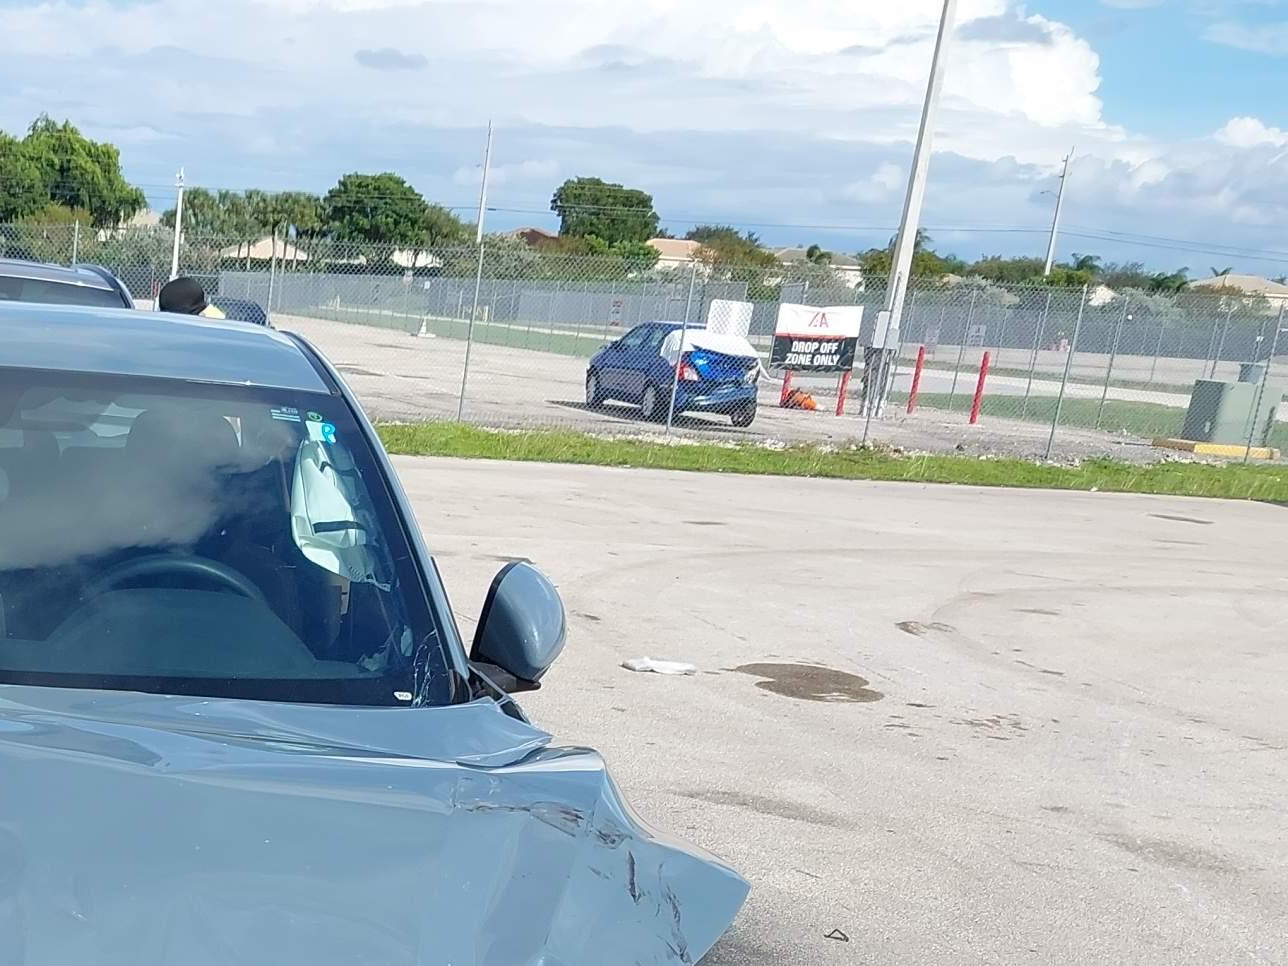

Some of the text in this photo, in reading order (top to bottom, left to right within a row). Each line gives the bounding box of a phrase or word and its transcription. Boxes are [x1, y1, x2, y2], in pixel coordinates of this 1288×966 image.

[792, 341, 839, 354] DROP OFF
[784, 353, 840, 366] ZONE ONLY
